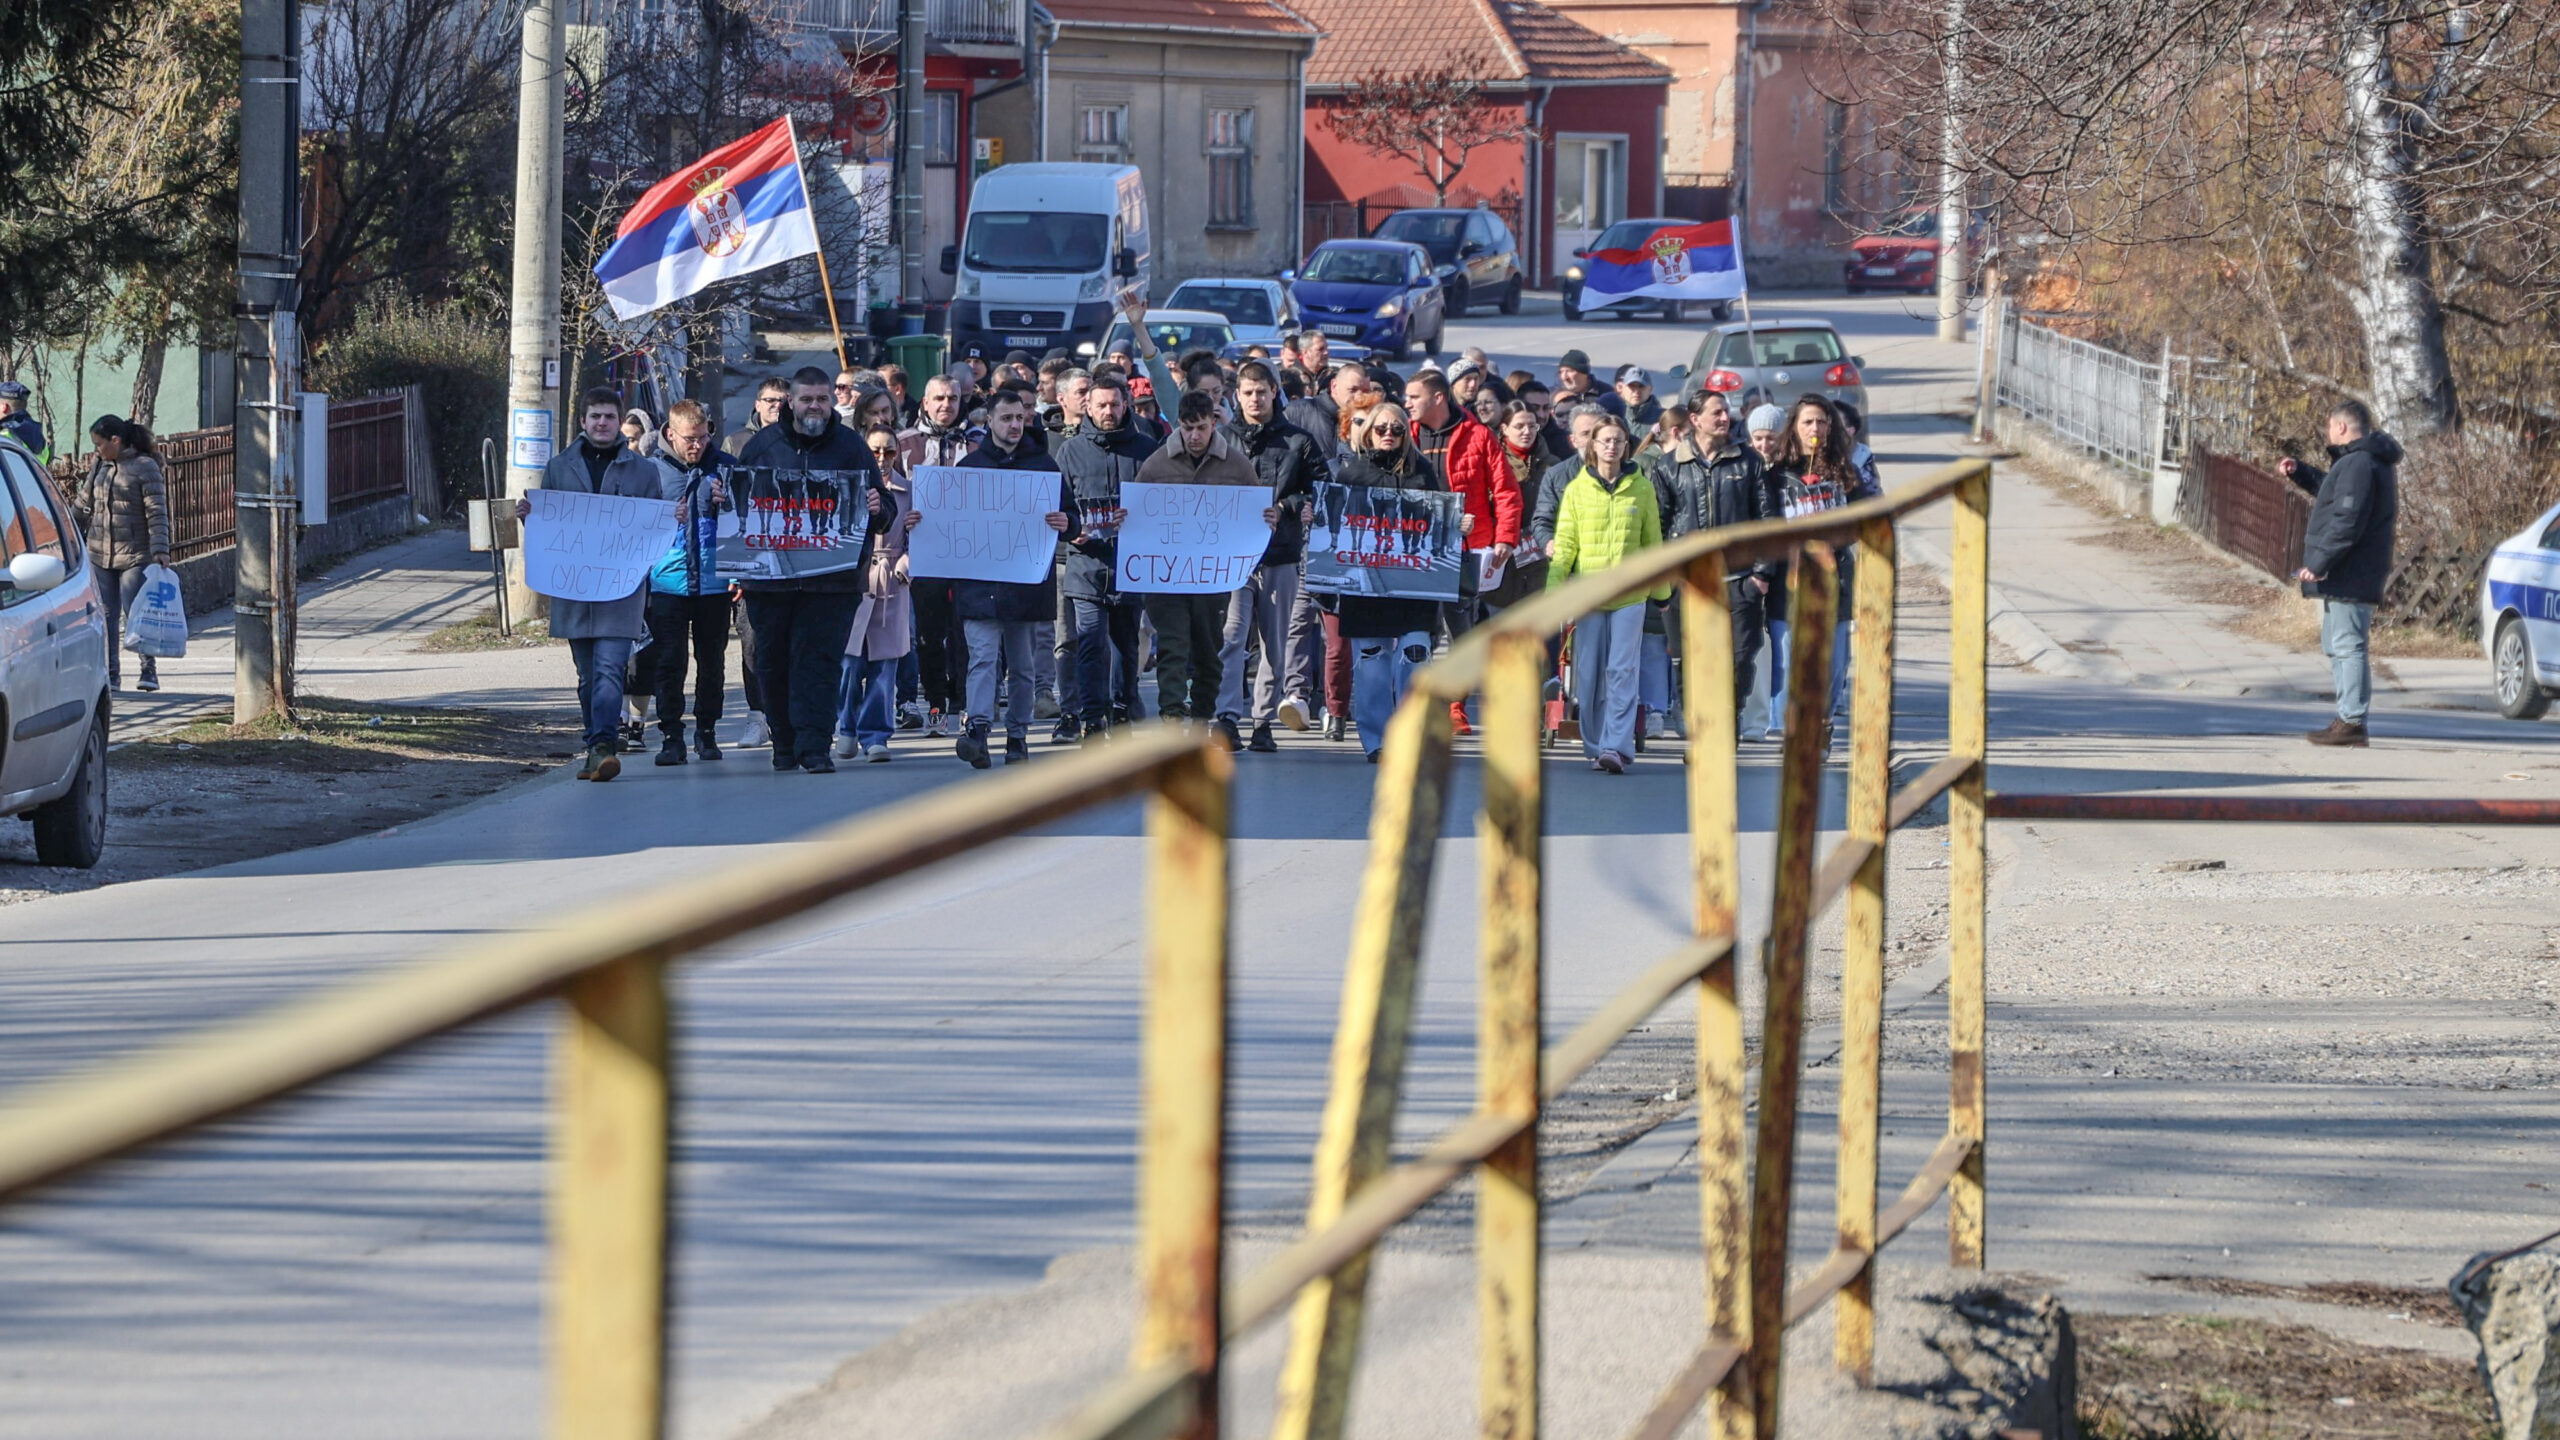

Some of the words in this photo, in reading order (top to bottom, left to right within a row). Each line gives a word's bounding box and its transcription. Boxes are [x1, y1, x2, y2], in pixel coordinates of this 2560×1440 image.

[752, 496, 835, 513] ХОДАЈМО
[914, 471, 1052, 515] КОРУПЦИЈА
[1144, 487, 1252, 521] СВРЉИГ
[542, 491, 636, 529] БИТНО
[643, 503, 676, 531] ЈЕ
[1345, 513, 1428, 533] ХОДАЈМО
[784, 516, 803, 531] УЗ
[1160, 522, 1183, 545] ЈЕ
[1197, 521, 1220, 545] УЗ
[544, 529, 584, 554] ДА
[936, 520, 1048, 566] УБИЈА!!
[1375, 534, 1395, 551] УЗ
